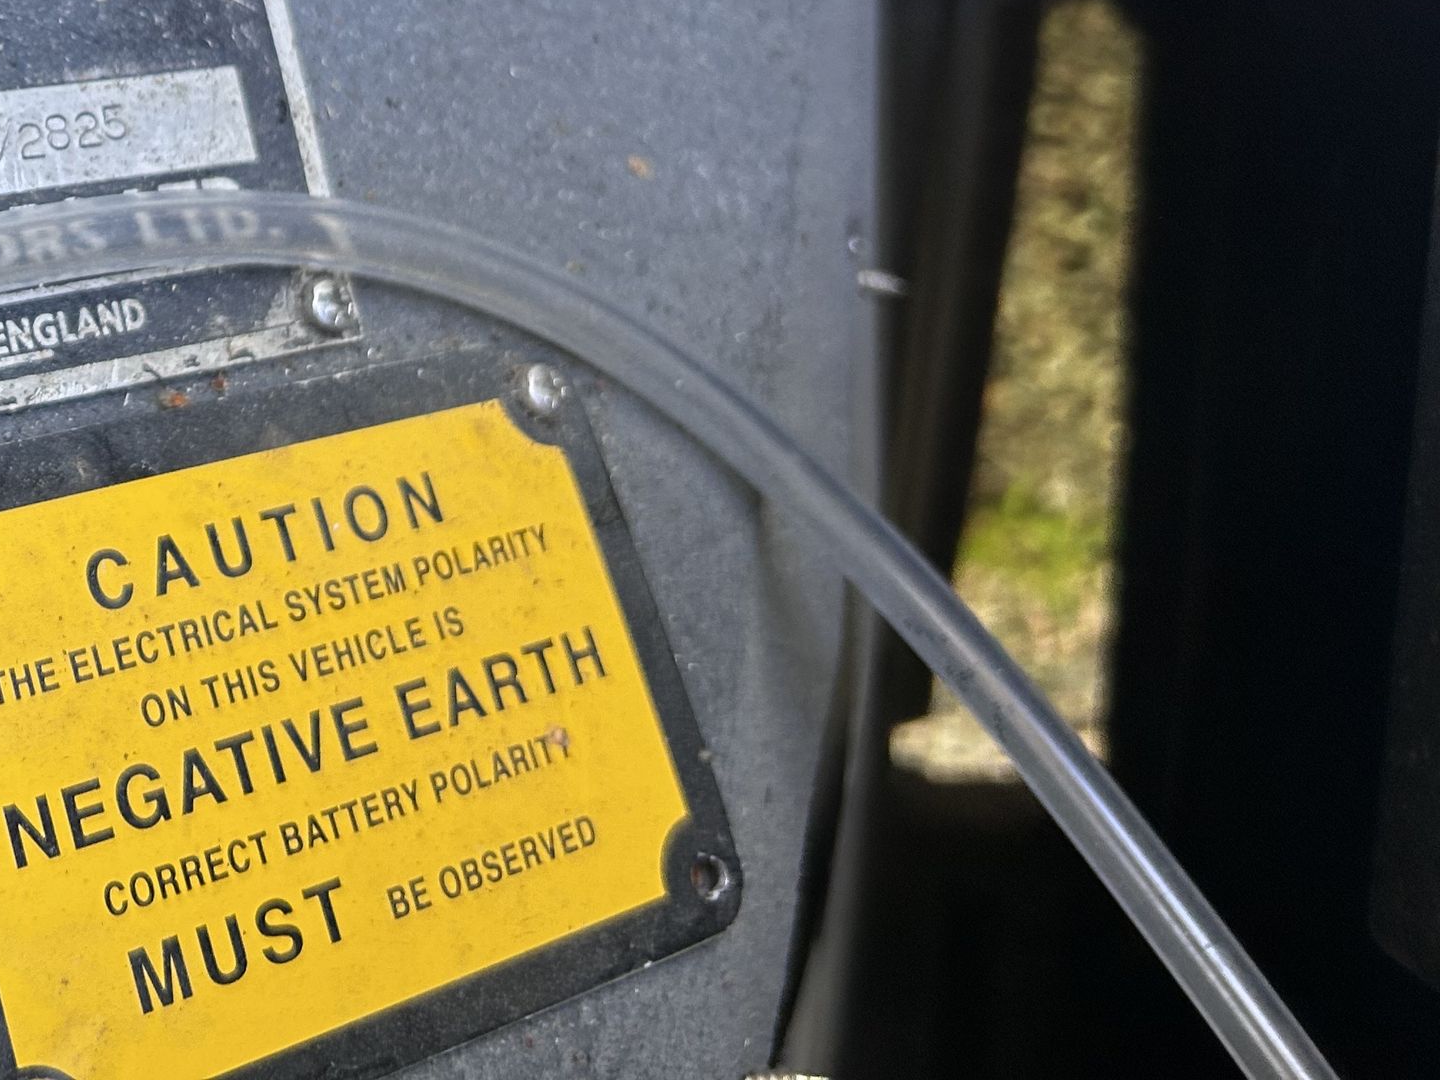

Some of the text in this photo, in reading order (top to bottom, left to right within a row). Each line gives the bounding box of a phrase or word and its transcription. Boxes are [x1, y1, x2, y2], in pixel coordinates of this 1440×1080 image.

[69, 602, 277, 683] ELECTRICAL
[286, 565, 406, 622] SYSTEM
[415, 523, 550, 585] POLARITY
[87, 472, 443, 610] CAUTION
[4, 628, 607, 870] NEGATIVE EARTH
[142, 607, 464, 726] ON THIS VEHICLE IS
[105, 728, 572, 917] CORRECT BATTERY POLARITY
[128, 815, 596, 1015] MUST BE OBSERVED
